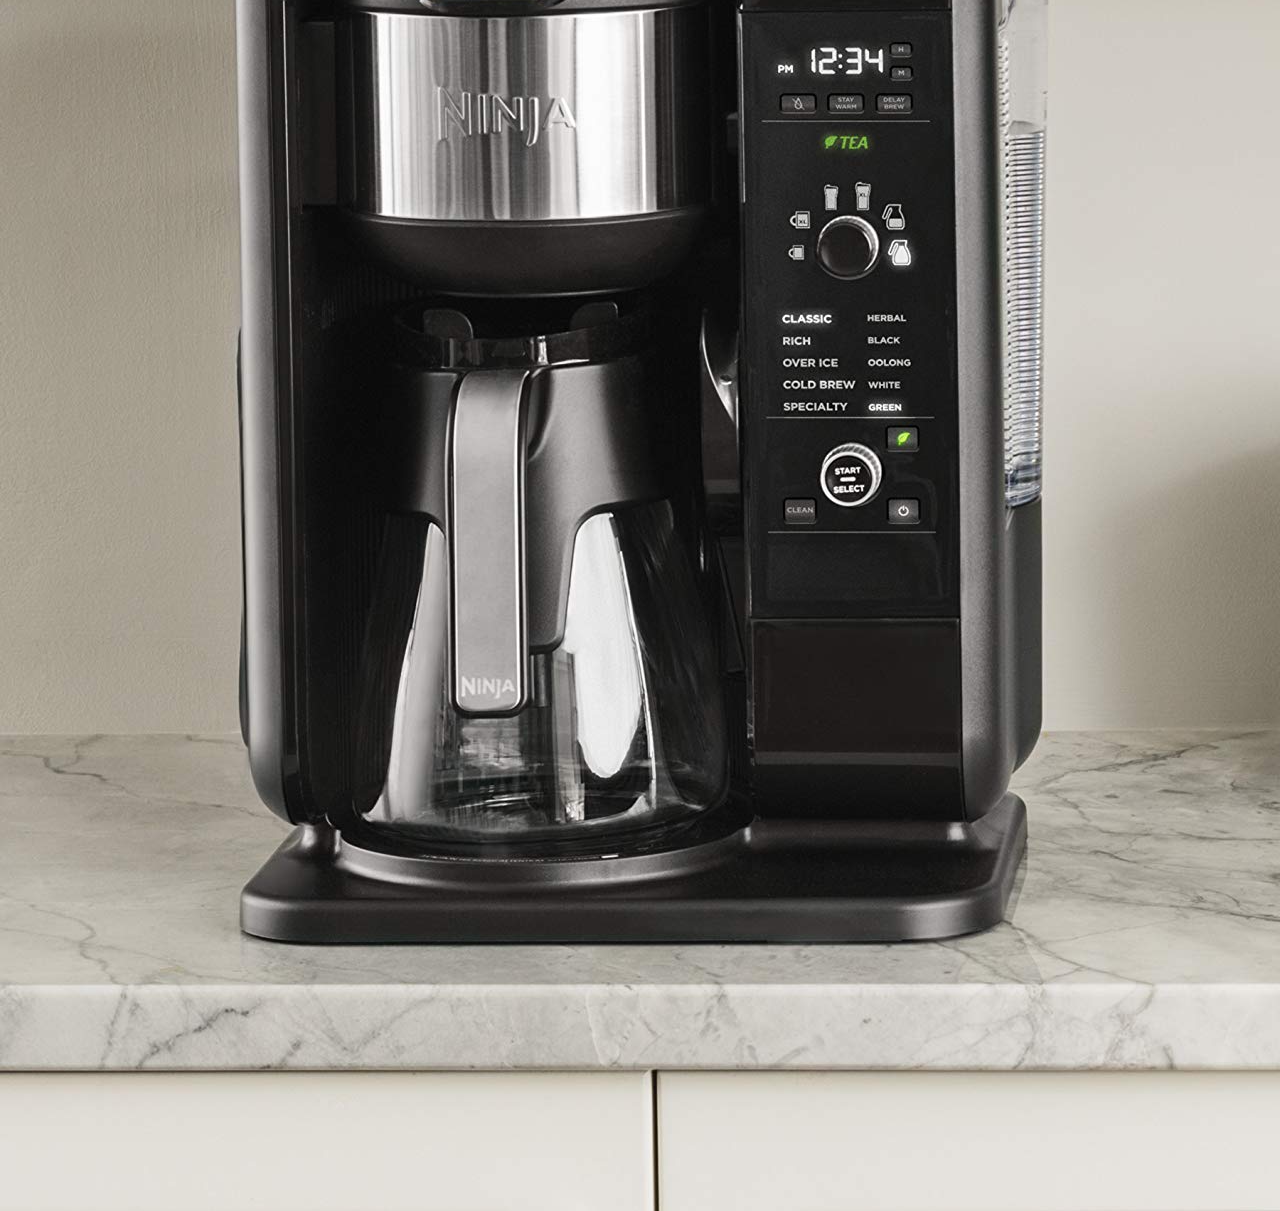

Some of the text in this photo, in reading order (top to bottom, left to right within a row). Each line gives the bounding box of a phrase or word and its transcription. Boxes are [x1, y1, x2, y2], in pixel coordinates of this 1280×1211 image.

[810, 47, 884, 75] 12:34
[777, 64, 794, 74] PM
[437, 86, 577, 147] NINJA
[840, 136, 869, 150] TEA
[781, 314, 833, 324] CLASSIC
[867, 314, 907, 322] HERBAL
[782, 336, 811, 346] RICH
[867, 336, 901, 344] BLACK
[782, 358, 839, 368] OVER ICE
[867, 358, 912, 367] OOLONG
[783, 380, 856, 390] COLD BREW
[868, 381, 901, 389] WHITE
[783, 402, 848, 412] SPECIALTY
[868, 403, 902, 412] GREEN
[834, 466, 861, 475] START
[833, 484, 865, 494] SELECT
[786, 506, 814, 514] CLEAN
[460, 675, 516, 700] NINJA
